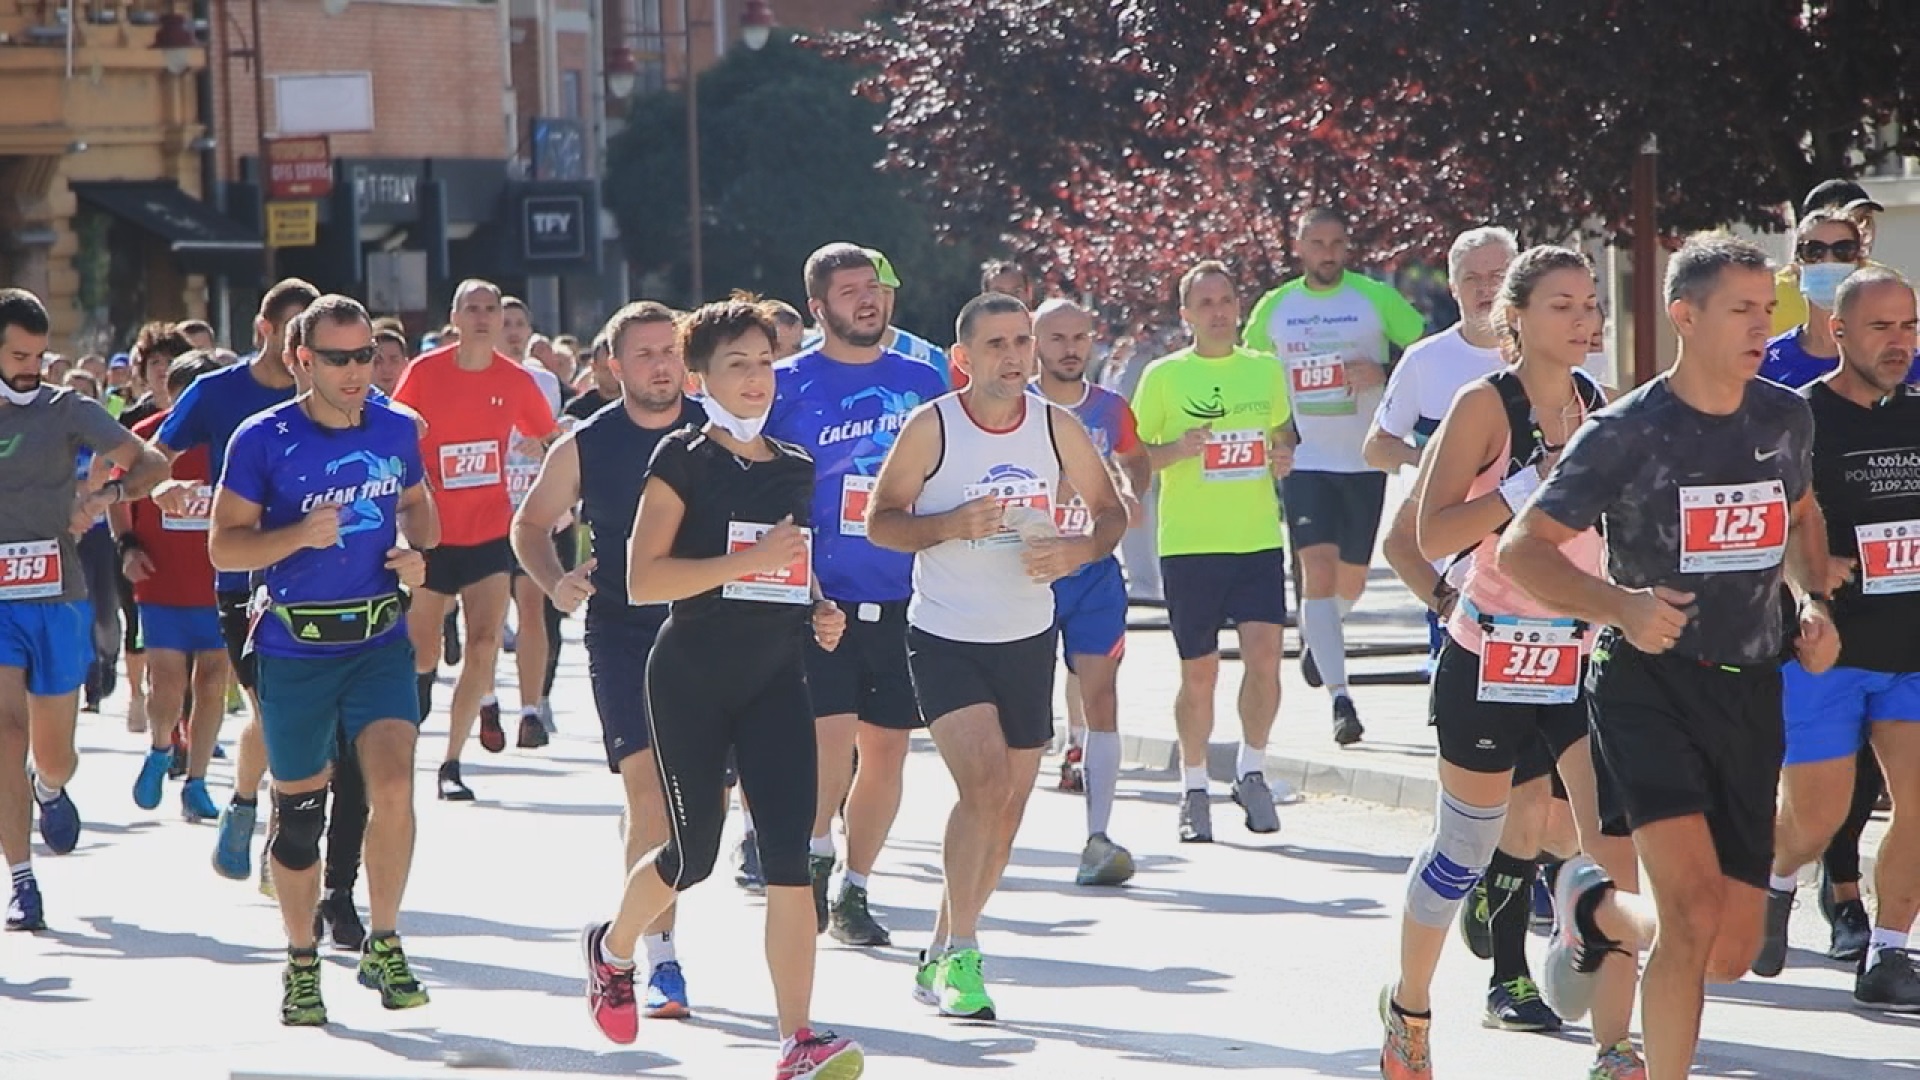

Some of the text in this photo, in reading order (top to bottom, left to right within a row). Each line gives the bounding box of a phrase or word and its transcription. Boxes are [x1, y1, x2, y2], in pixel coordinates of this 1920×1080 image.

[533, 214, 571, 232] TFY
[1301, 366, 1334, 388] 099
[818, 419, 874, 446] ČAČAK
[455, 455, 486, 474] 270
[1218, 443, 1252, 465] 375
[1060, 508, 1088, 530] 19
[1709, 506, 1768, 543] 125
[4, 557, 47, 580] 369
[1503, 645, 1561, 676] 319
